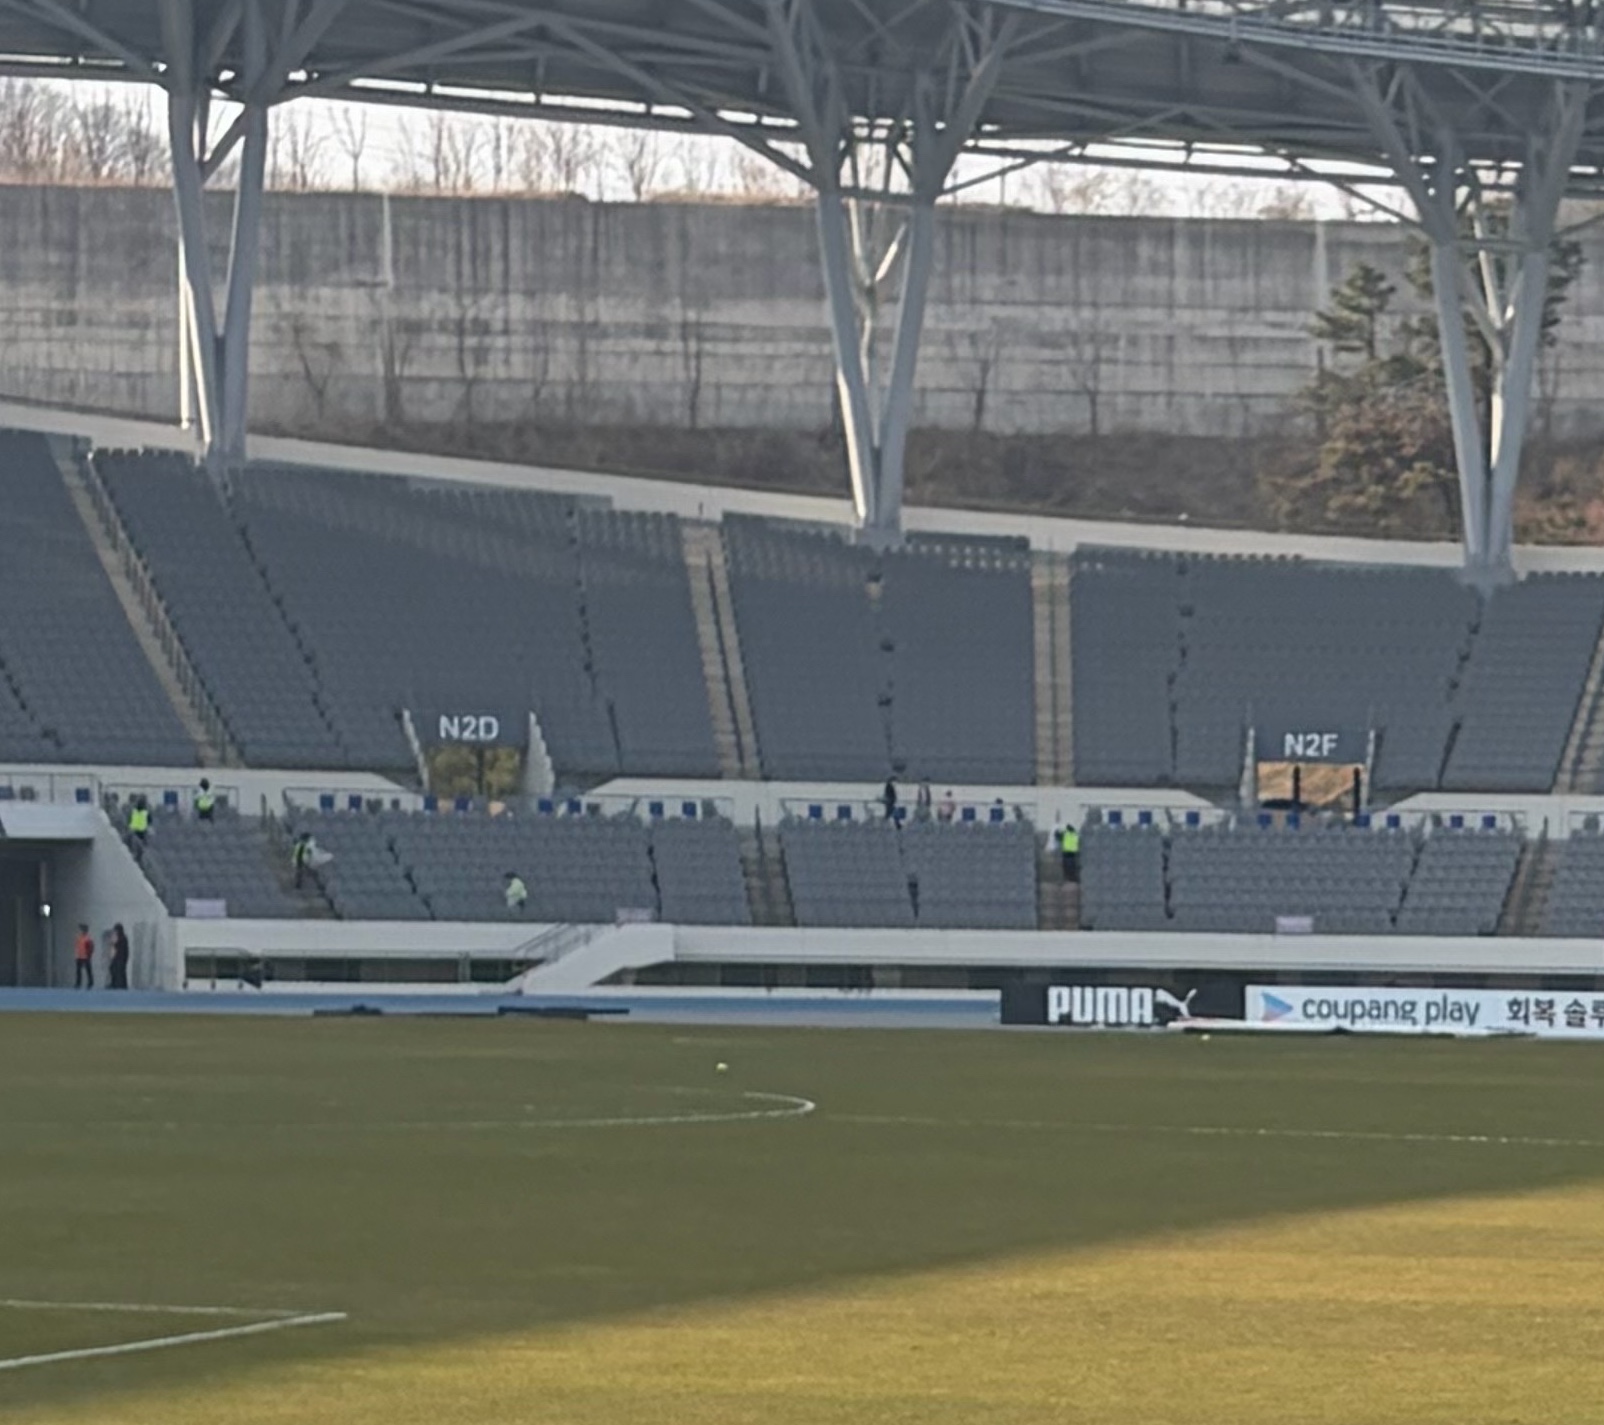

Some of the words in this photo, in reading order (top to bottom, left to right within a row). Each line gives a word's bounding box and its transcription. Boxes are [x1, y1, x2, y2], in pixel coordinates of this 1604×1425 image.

[439, 715, 499, 740] N2D
[1284, 733, 1338, 757] N2F
[1048, 987, 1153, 1023] PUMA
[1302, 999, 1417, 1026] coupang
[1425, 994, 1480, 1026] play
[1507, 998, 1555, 1031] 회복
